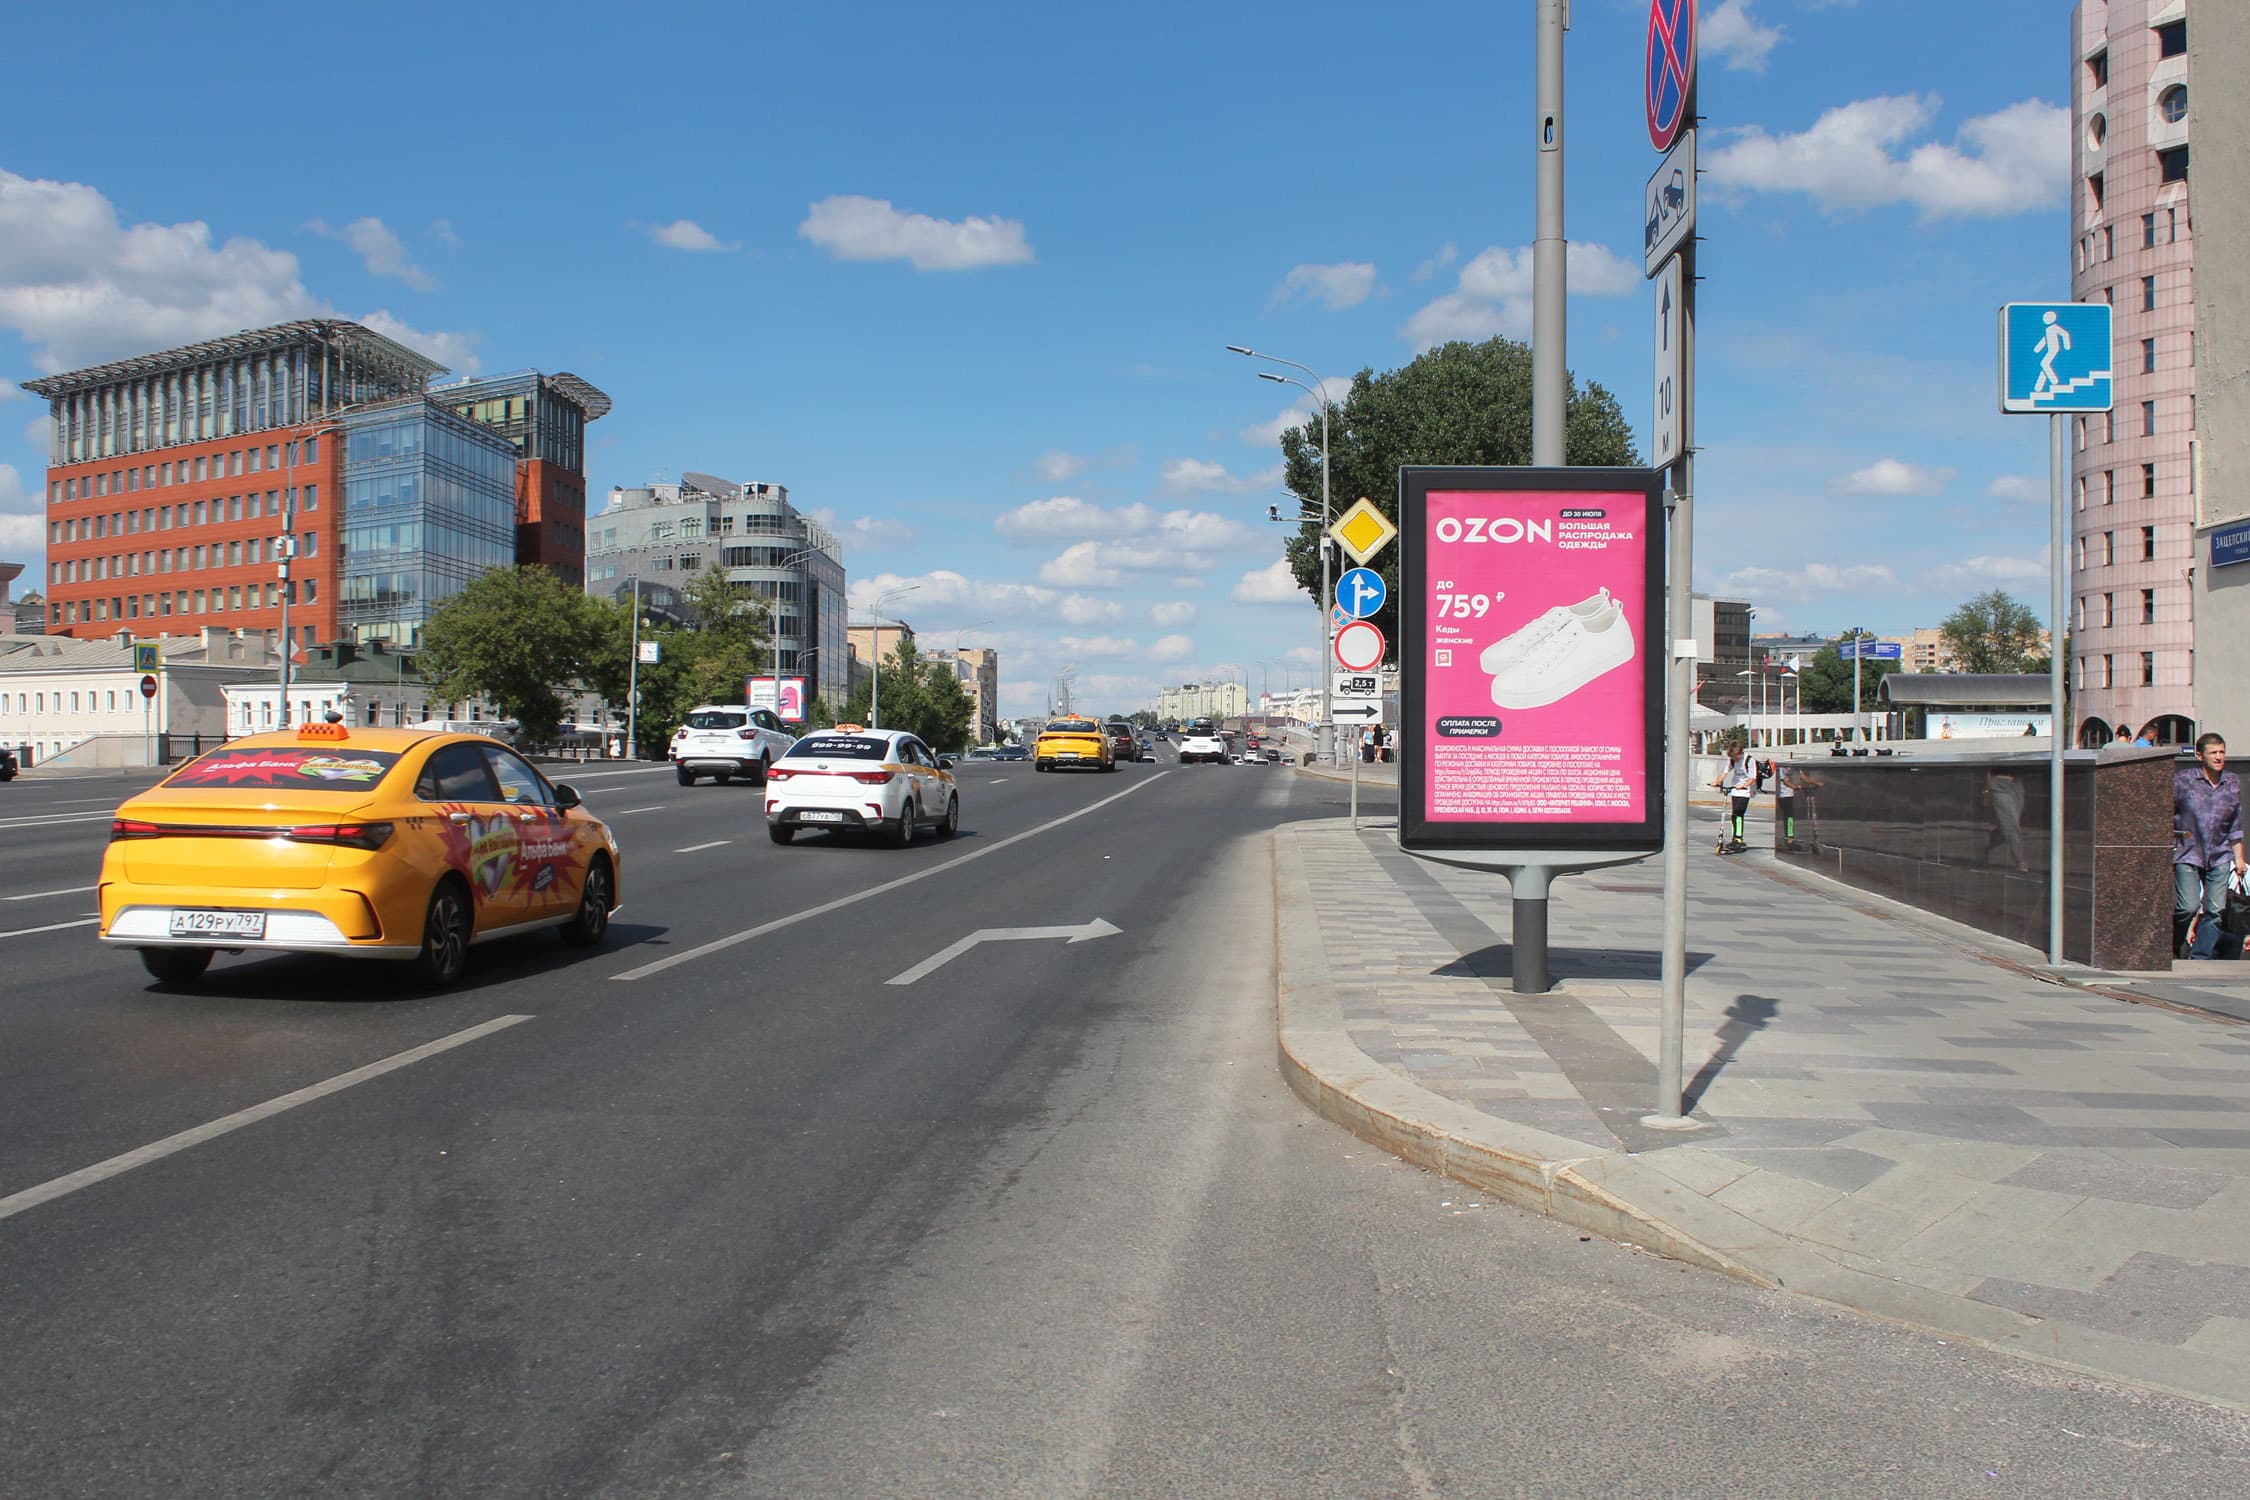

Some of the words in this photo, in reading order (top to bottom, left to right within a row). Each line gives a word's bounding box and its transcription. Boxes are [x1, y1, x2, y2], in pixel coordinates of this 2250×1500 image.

[1658, 376, 1671, 420] 10
[1436, 517, 1552, 544] OZON
[1559, 522, 1610, 530] БОЛЬШАЯ
[1559, 532, 1633, 540] РАСПРОДАЖА
[1559, 541, 1607, 549] ОДЕЖДЫ
[1436, 581, 1454, 589] до
[1436, 594, 1490, 618] 759
[1435, 625, 1460, 634] Кеды
[811, 742, 871, 750] 999-99-99
[206, 761, 256, 770] Альфа
[258, 760, 299, 768] Банк
[237, 914, 260, 926] 797
